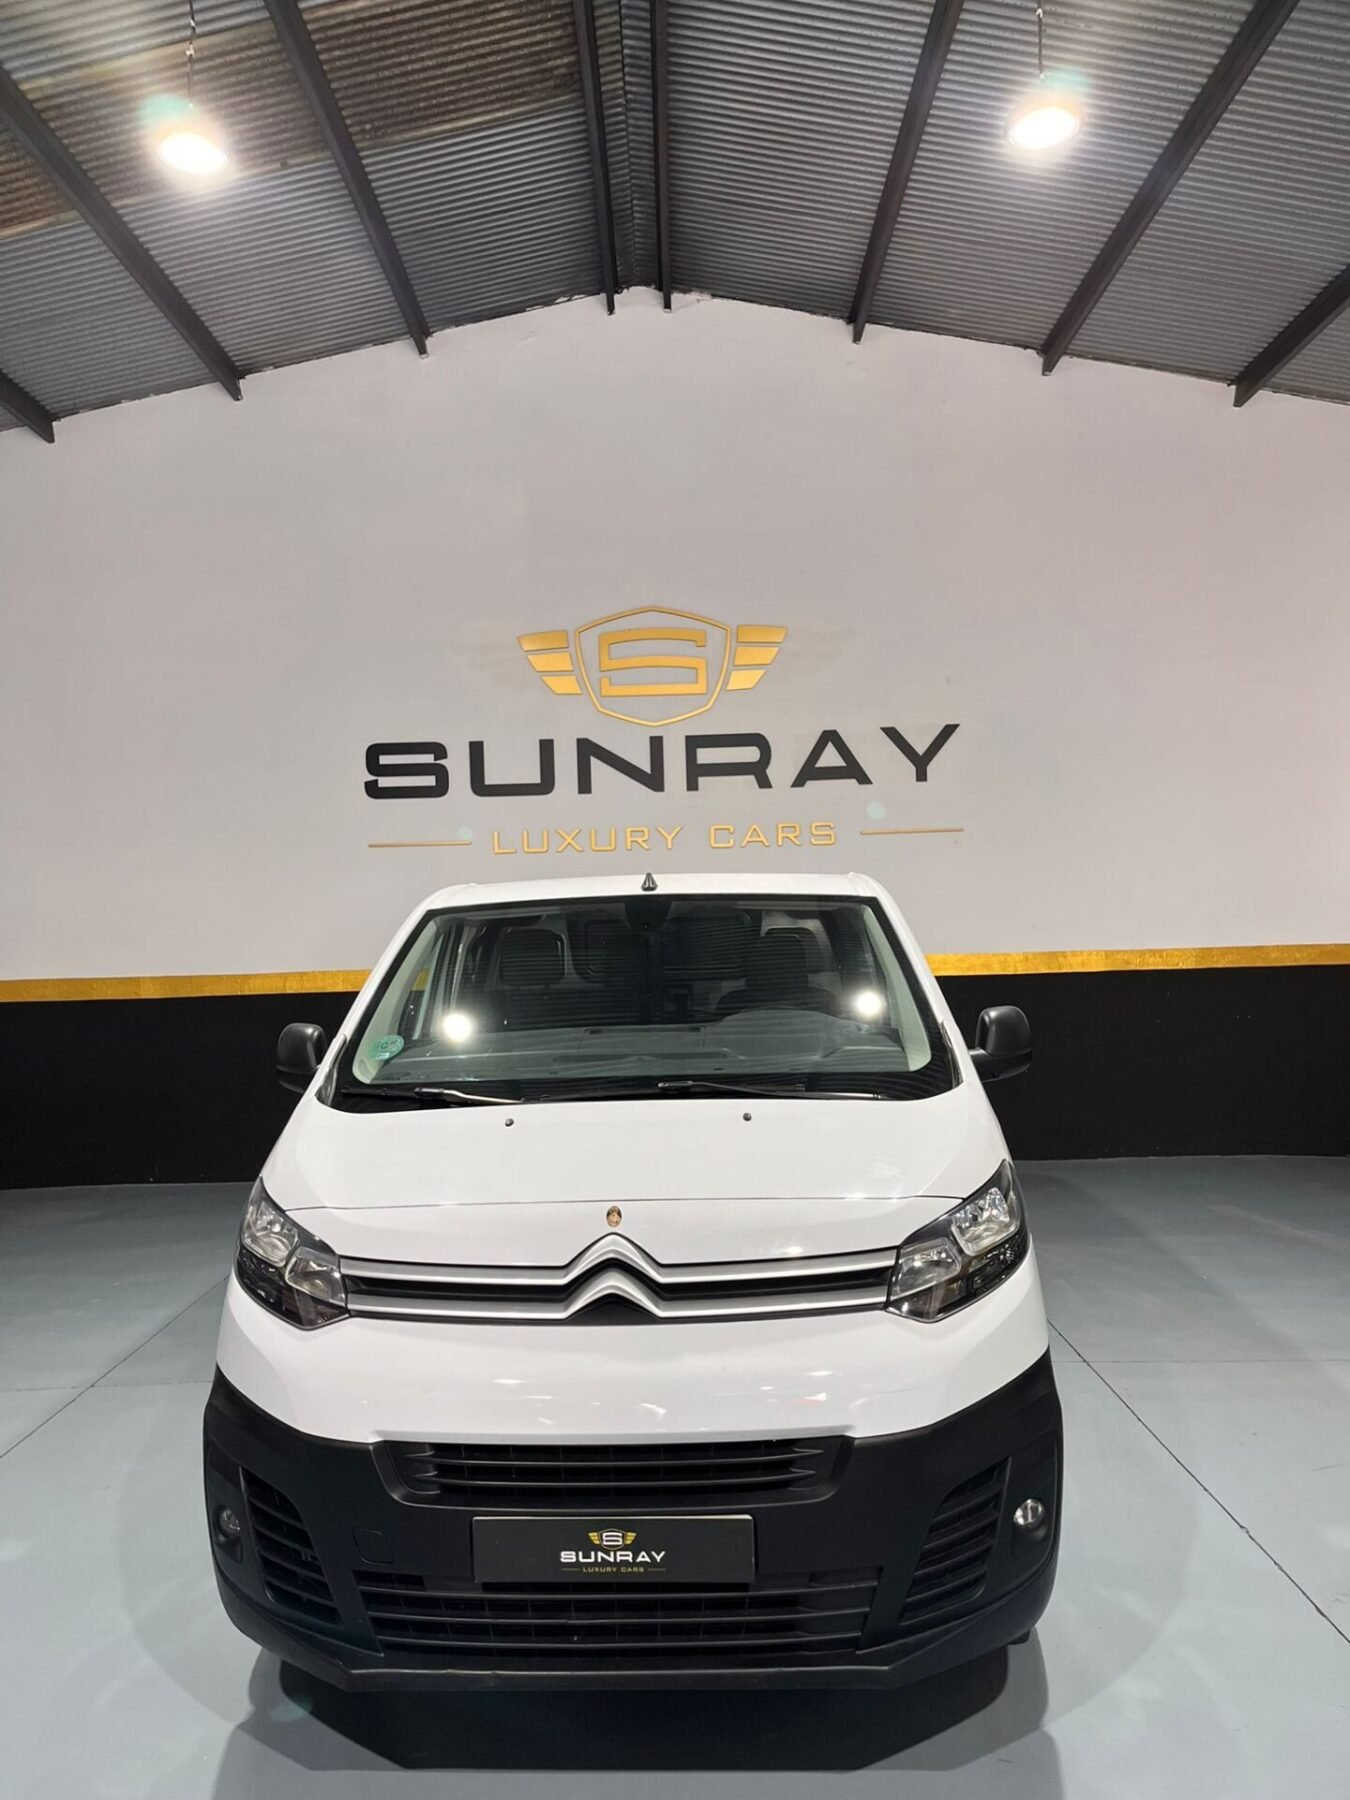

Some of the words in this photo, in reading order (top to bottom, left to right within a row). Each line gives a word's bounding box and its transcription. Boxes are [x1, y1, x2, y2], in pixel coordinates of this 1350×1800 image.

[599, 627, 708, 697] S
[364, 723, 961, 799] SUNRAY
[492, 826, 683, 855] LUXURY
[709, 821, 837, 849] CARS
[602, 1532, 623, 1545] S
[560, 1551, 666, 1563] SUNRAY
